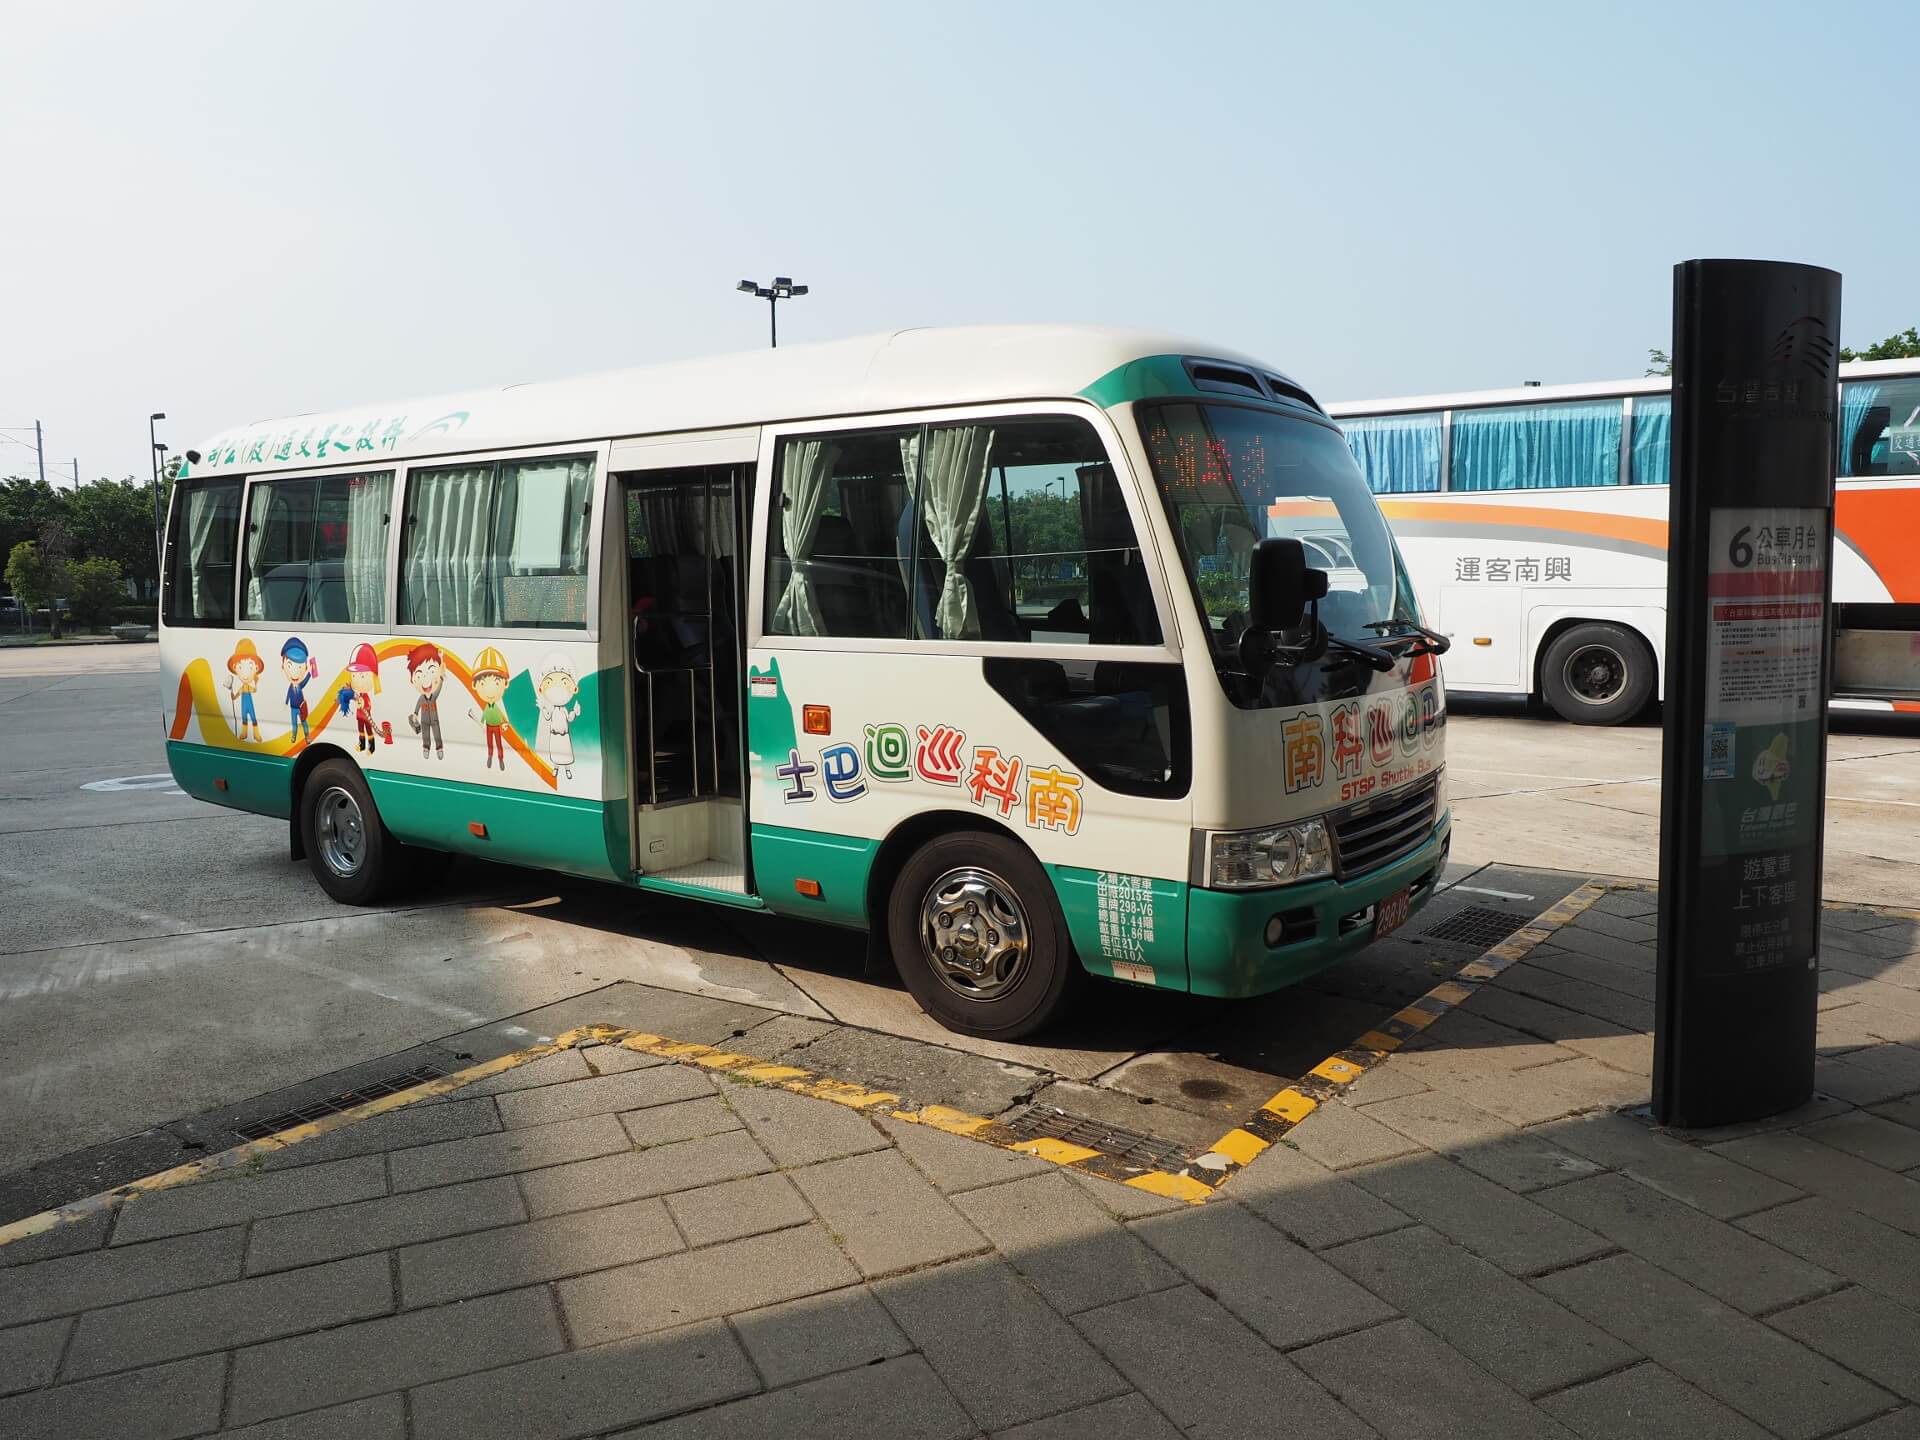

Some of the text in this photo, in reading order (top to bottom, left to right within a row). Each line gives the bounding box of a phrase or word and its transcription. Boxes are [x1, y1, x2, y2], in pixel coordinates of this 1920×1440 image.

[1729, 525, 1753, 568] 6
[1756, 525, 1816, 550] 公車月台
[1281, 686, 1446, 794] 南科巡迴巴
[1341, 776, 1376, 801] STSP
[1381, 764, 1414, 788] Shuttle
